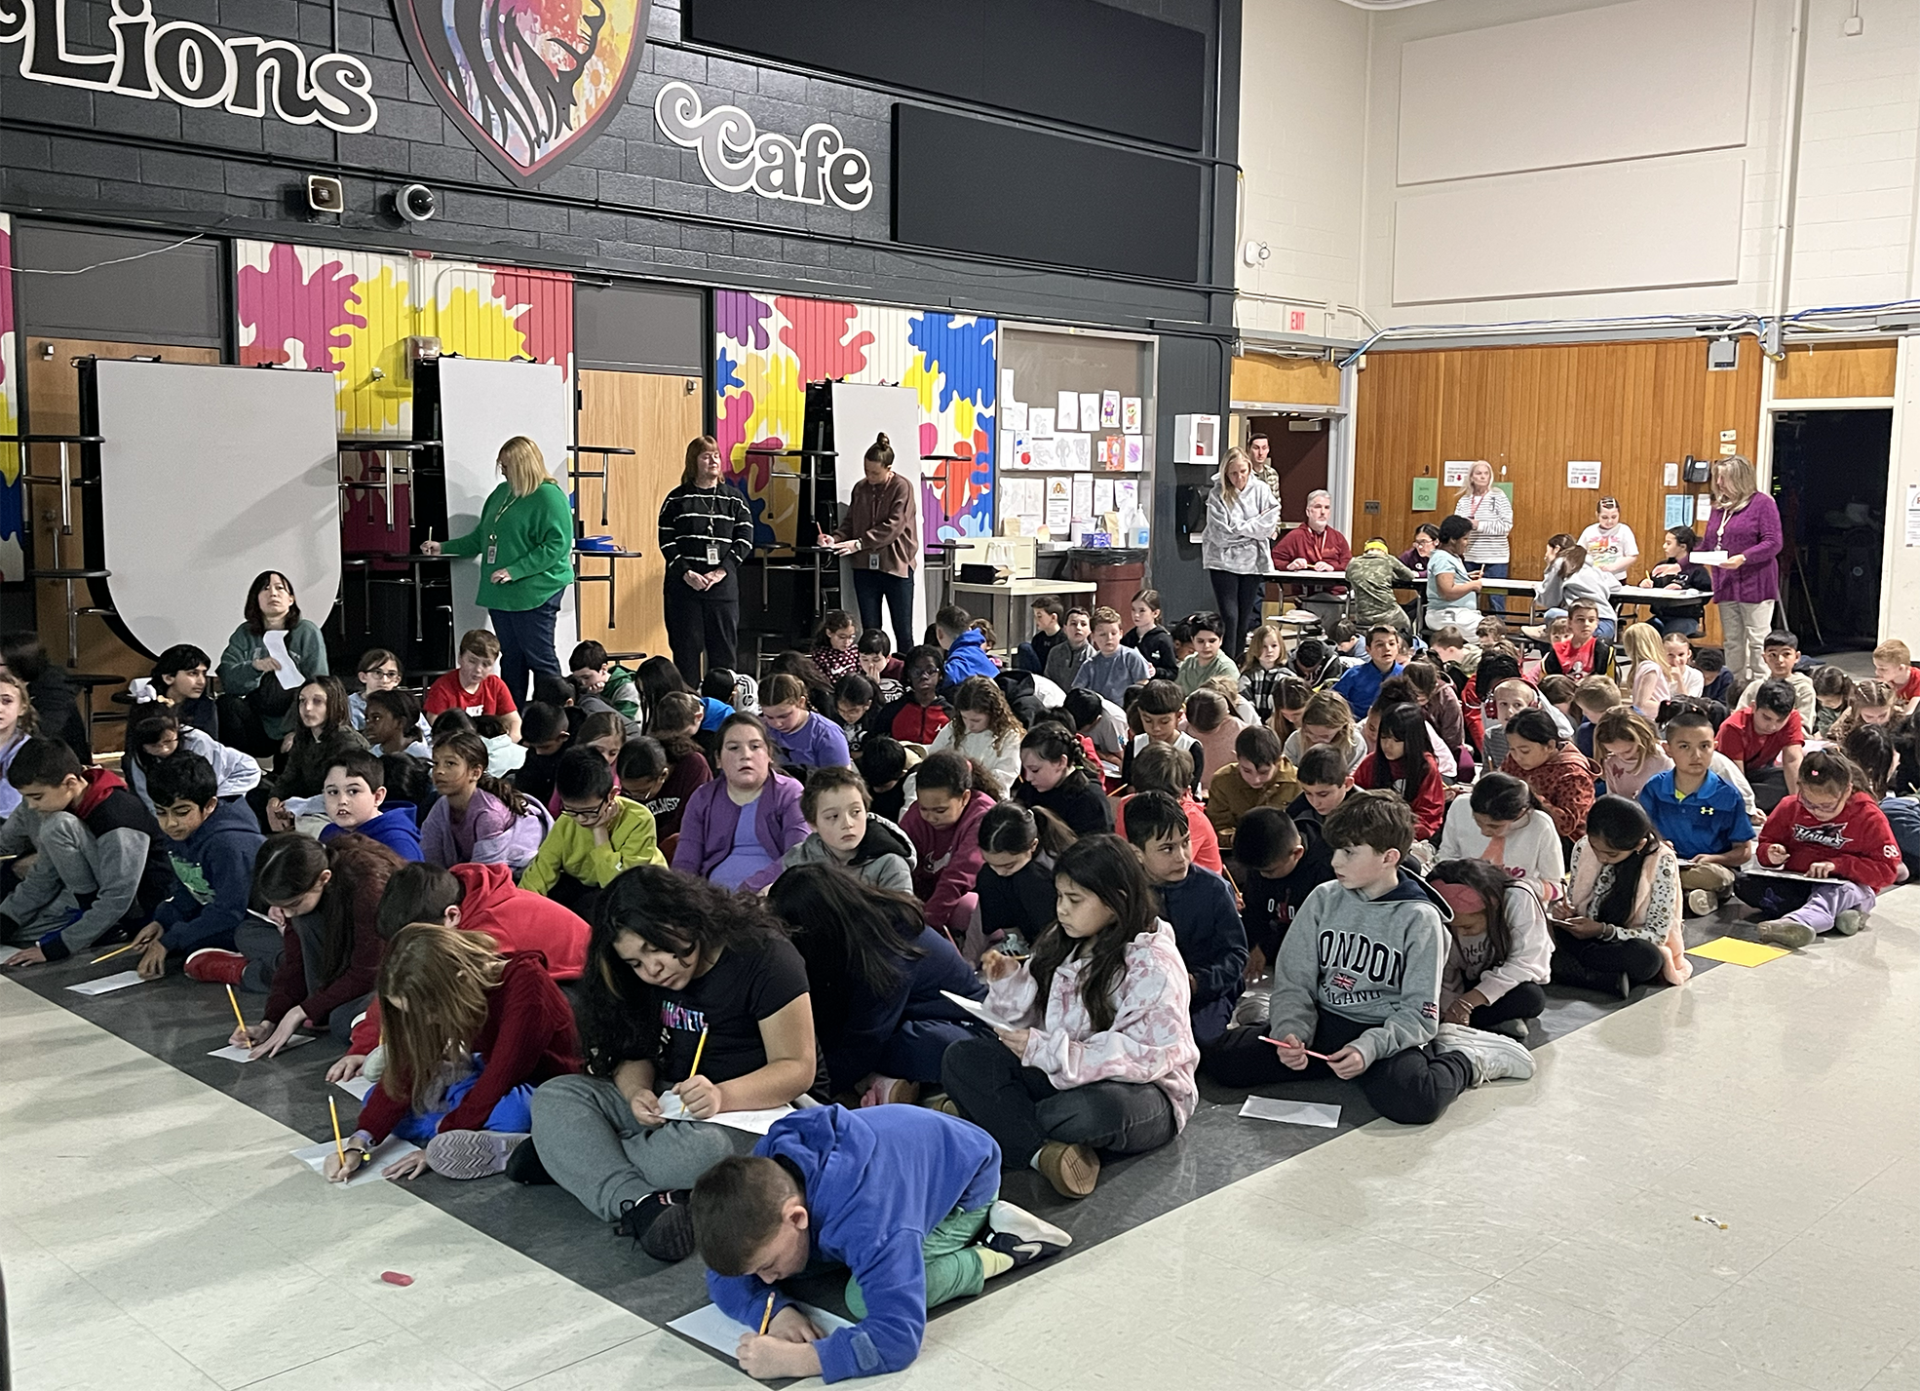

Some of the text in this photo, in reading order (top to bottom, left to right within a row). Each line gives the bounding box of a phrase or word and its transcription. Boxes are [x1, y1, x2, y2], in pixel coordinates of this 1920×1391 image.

[0, 0, 378, 134] Lions
[655, 81, 873, 211] Cafe
[1291, 311, 1305, 331] EXIT
[1319, 928, 1403, 988] ONDON
